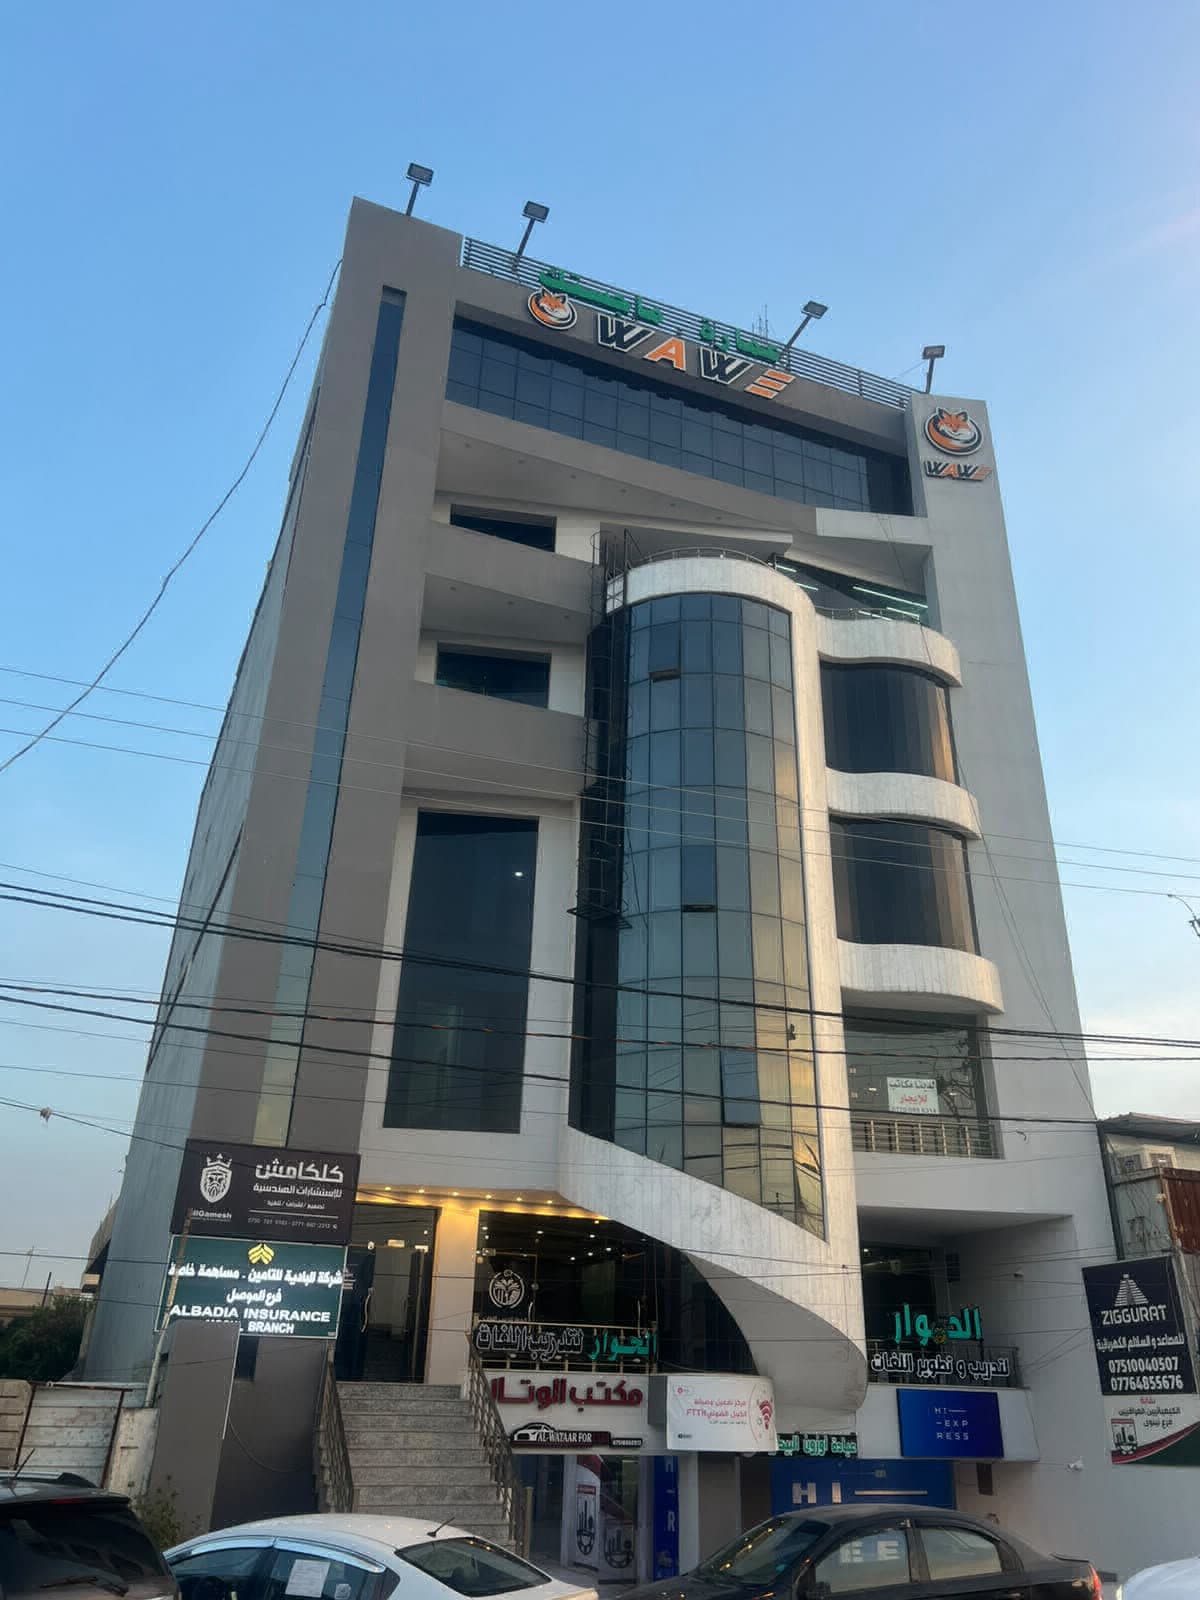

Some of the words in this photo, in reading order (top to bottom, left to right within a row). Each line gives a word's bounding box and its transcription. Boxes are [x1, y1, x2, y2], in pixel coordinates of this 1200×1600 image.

[255, 1158, 344, 1184] كلكامش
[253, 1182, 295, 1195] الهندسية
[197, 1264, 240, 1279] مساهمة
[284, 1269, 316, 1286] البادية
[317, 1270, 343, 1288] شركة
[226, 1288, 265, 1305] الموصل
[265, 1288, 282, 1307] فرع
[169, 1304, 239, 1318] ALBADIA
[243, 1307, 331, 1322] INSURANCE
[1101, 1304, 1167, 1326] ZIGGURAT
[247, 1321, 295, 1334] BRANCH
[587, 1328, 658, 1361] الحوار
[1127, 1335, 1151, 1351] السلالم
[1156, 1332, 1184, 1346] للمصاعد
[870, 1351, 914, 1373] اللغات
[917, 1354, 954, 1378] تطوير
[956, 1359, 967, 1379] و
[968, 1358, 1010, 1380] لتدريب
[1108, 1356, 1179, 1374] 07510040507
[1110, 1374, 1184, 1392] 07764855676
[569, 1379, 644, 1413] مكتب
[578, 1432, 593, 1443] FOR
[936, 1432, 969, 1441] RESS
[831, 1437, 857, 1459] عيادة
